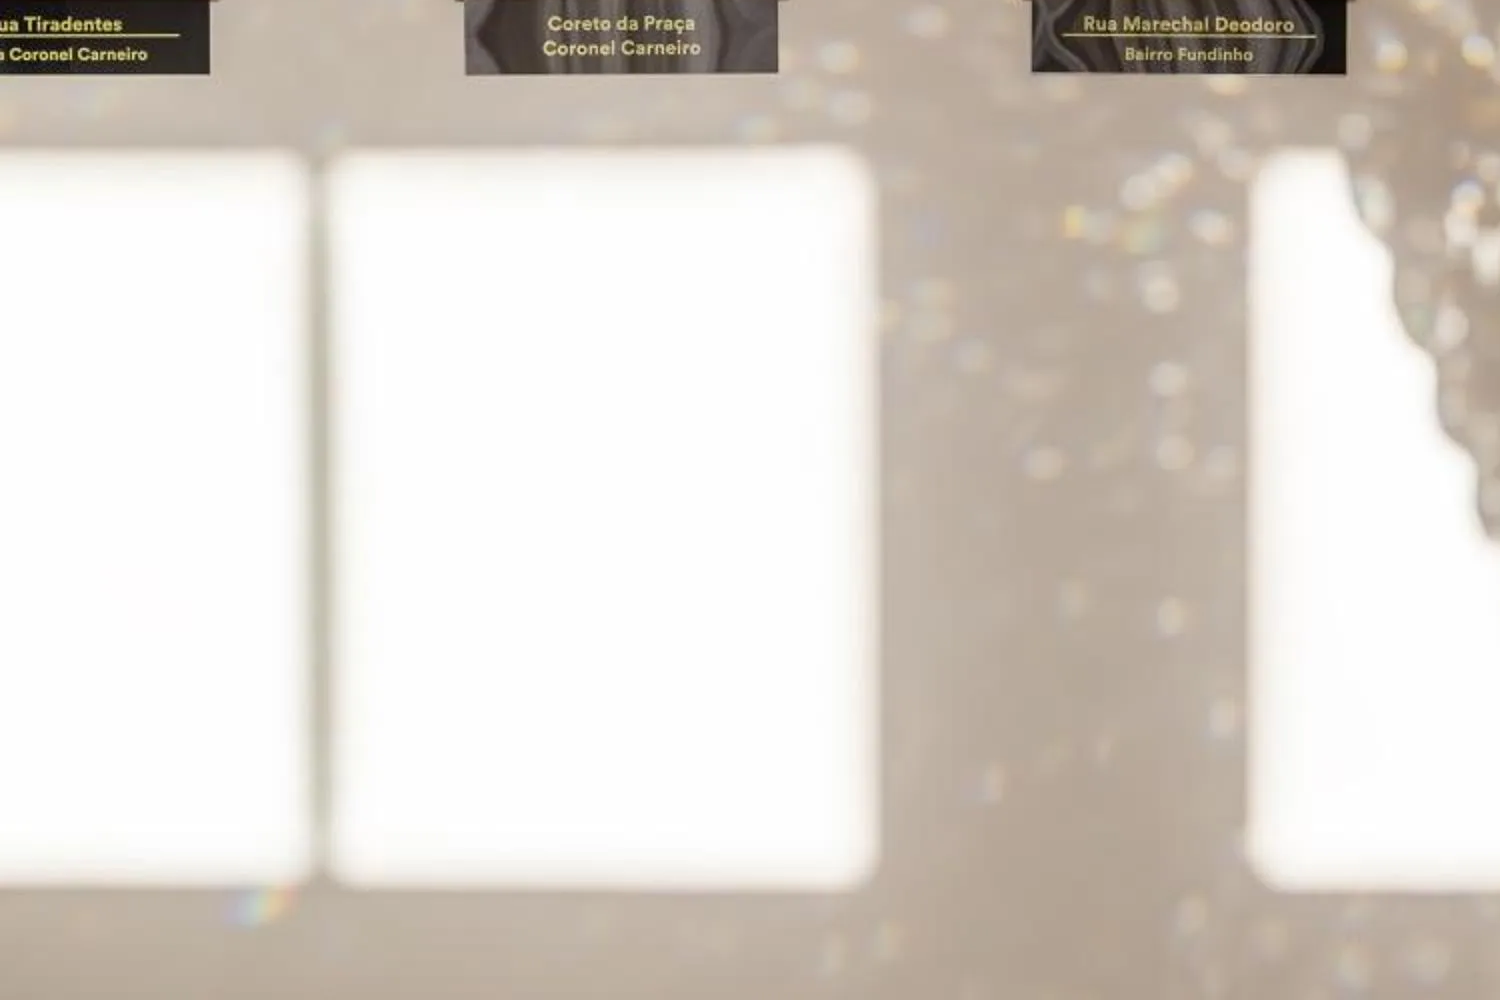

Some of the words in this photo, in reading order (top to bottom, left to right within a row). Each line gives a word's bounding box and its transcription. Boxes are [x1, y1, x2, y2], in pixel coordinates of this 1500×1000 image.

[23, 16, 123, 32] Tiradentes
[548, 16, 611, 31] Coreto
[616, 16, 639, 31] da
[644, 15, 696, 35] Praça
[1083, 16, 1117, 32] Rua
[1124, 16, 1209, 33] Marechal
[1215, 16, 1295, 33] Deodoro
[9, 47, 72, 62] Coronel
[77, 46, 149, 62] Carneiro
[543, 40, 615, 56] Coronel
[621, 39, 702, 56] Carneiro
[1125, 47, 1173, 62] Bairro
[1178, 46, 1254, 62] Fundinho
